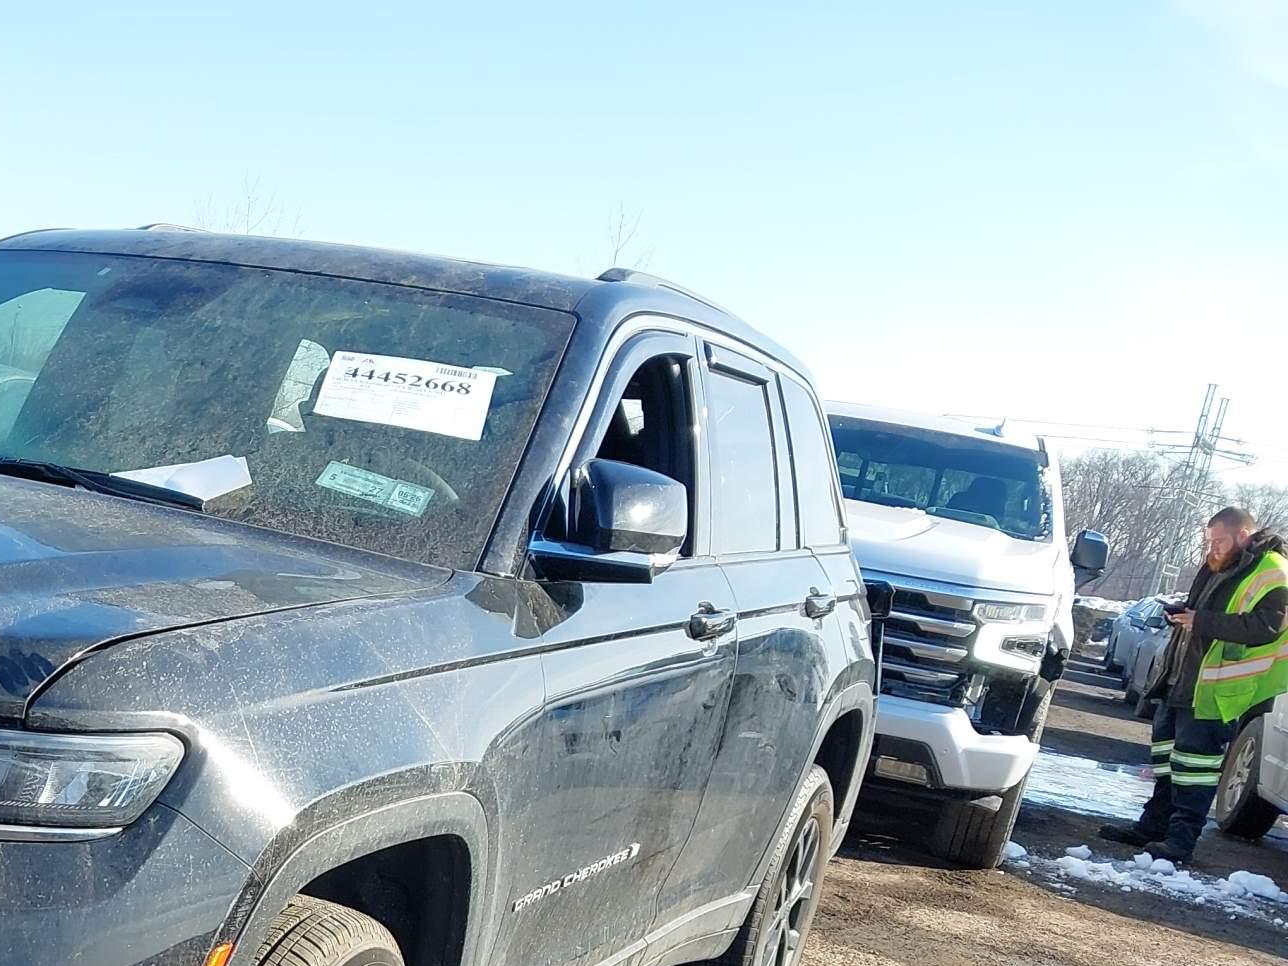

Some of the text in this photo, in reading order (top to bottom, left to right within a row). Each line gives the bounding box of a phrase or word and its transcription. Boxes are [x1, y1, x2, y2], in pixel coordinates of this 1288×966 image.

[344, 366, 472, 396] 44452668
[514, 848, 631, 912] GRAND CHEROKEE
